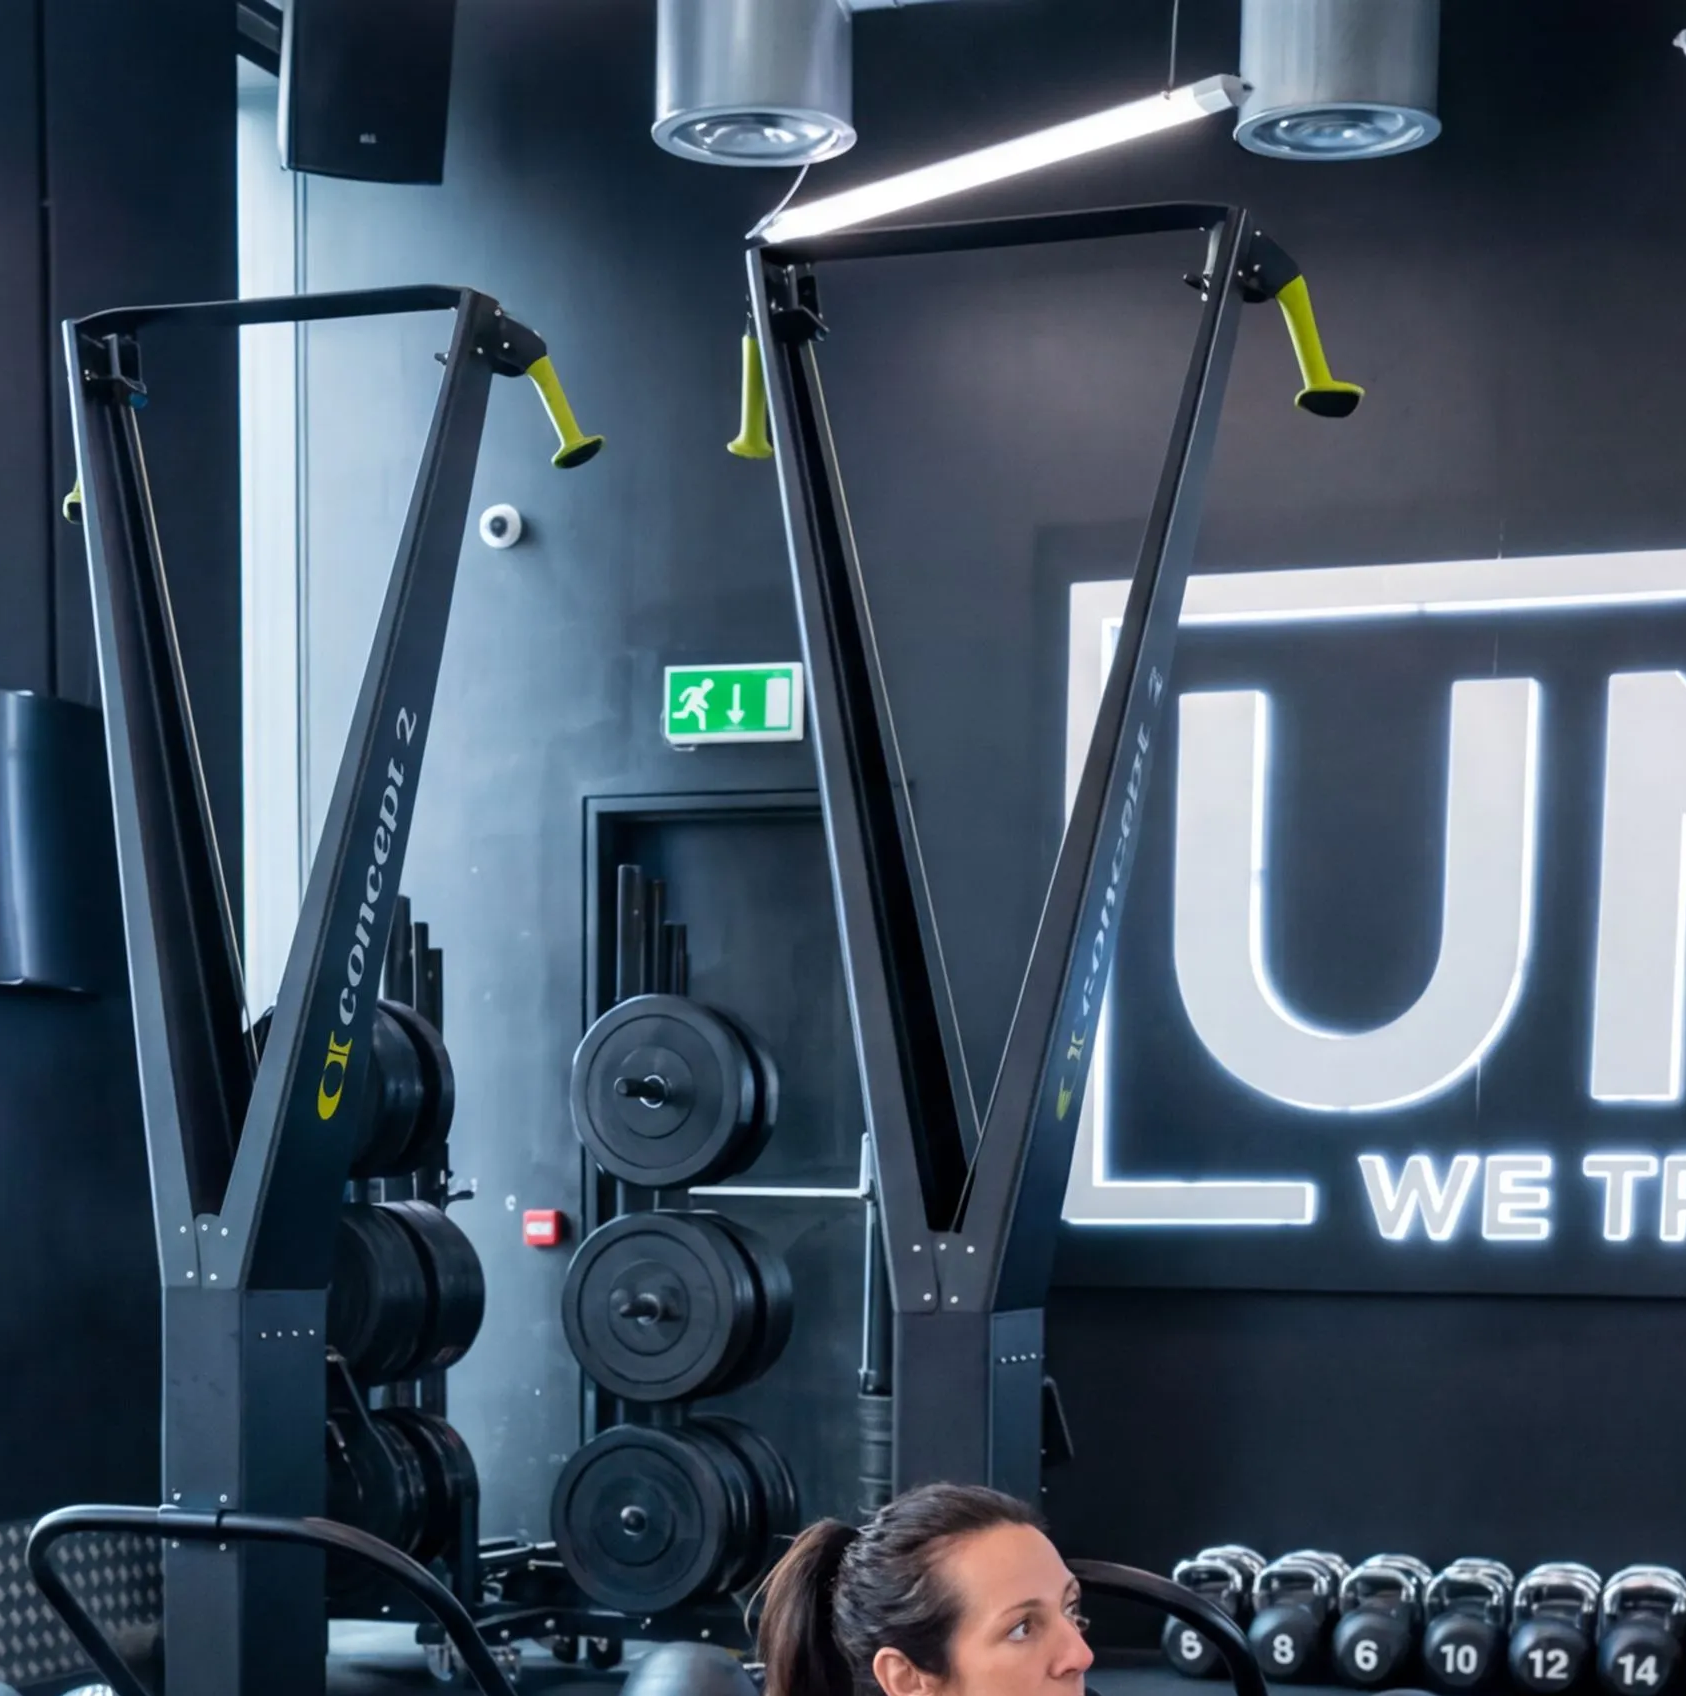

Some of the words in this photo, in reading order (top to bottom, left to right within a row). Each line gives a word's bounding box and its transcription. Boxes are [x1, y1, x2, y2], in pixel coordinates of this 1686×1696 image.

[339, 757, 405, 1026] concept
[395, 706, 417, 747] 2
[1358, 1154, 1553, 1242] WE
[1272, 1633, 1295, 1665] 8
[1353, 1639, 1379, 1672] 6
[1440, 1644, 1479, 1675] 10
[1528, 1648, 1570, 1680] 12
[1618, 1653, 1660, 1687] 14
